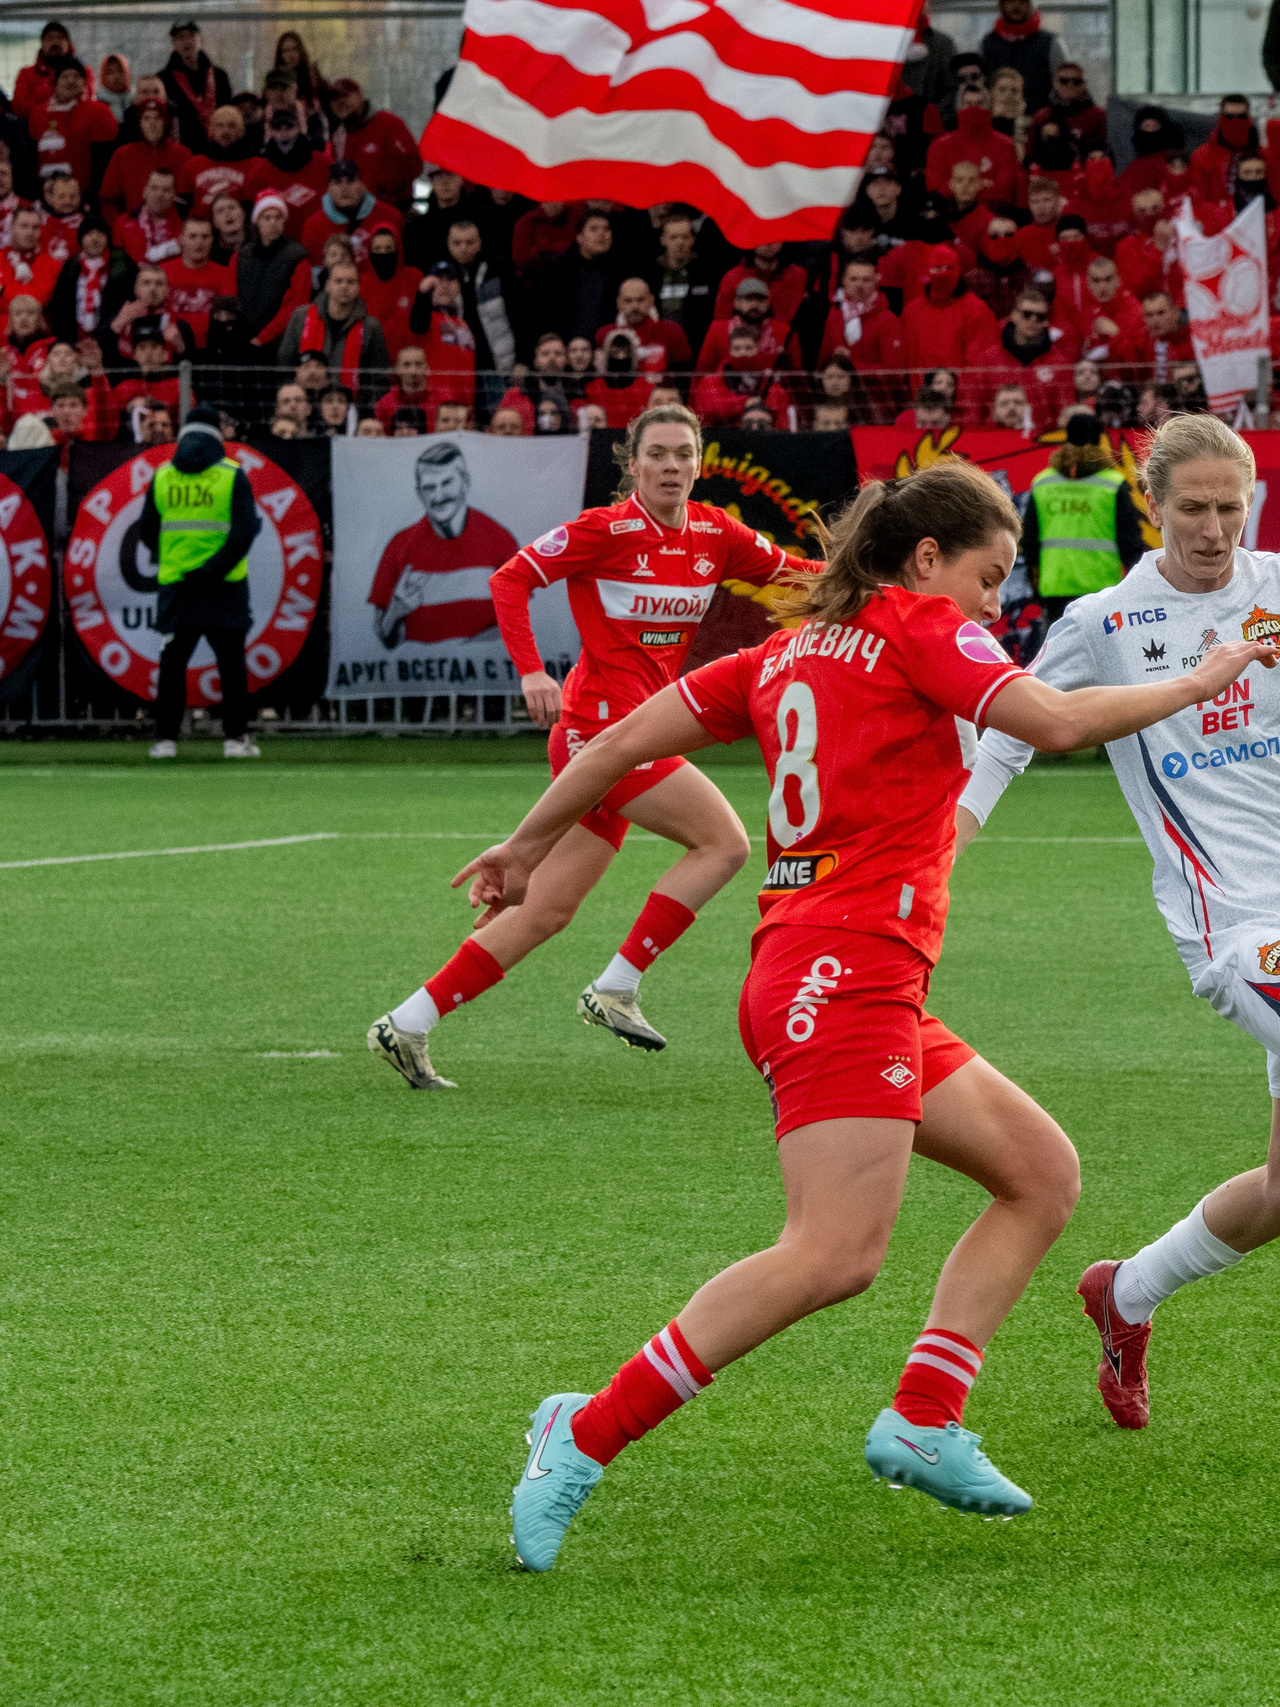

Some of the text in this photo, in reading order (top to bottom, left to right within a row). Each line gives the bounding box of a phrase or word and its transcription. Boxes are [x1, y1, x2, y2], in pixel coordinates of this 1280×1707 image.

[69, 450, 320, 569] SPATAK
[1127, 607, 1168, 627] ПСБ
[641, 632, 681, 645] WINLINE
[502, 652, 573, 682] ТОЙ
[1196, 678, 1250, 711] ON
[1202, 703, 1255, 736] BET
[768, 681, 821, 850] 8
